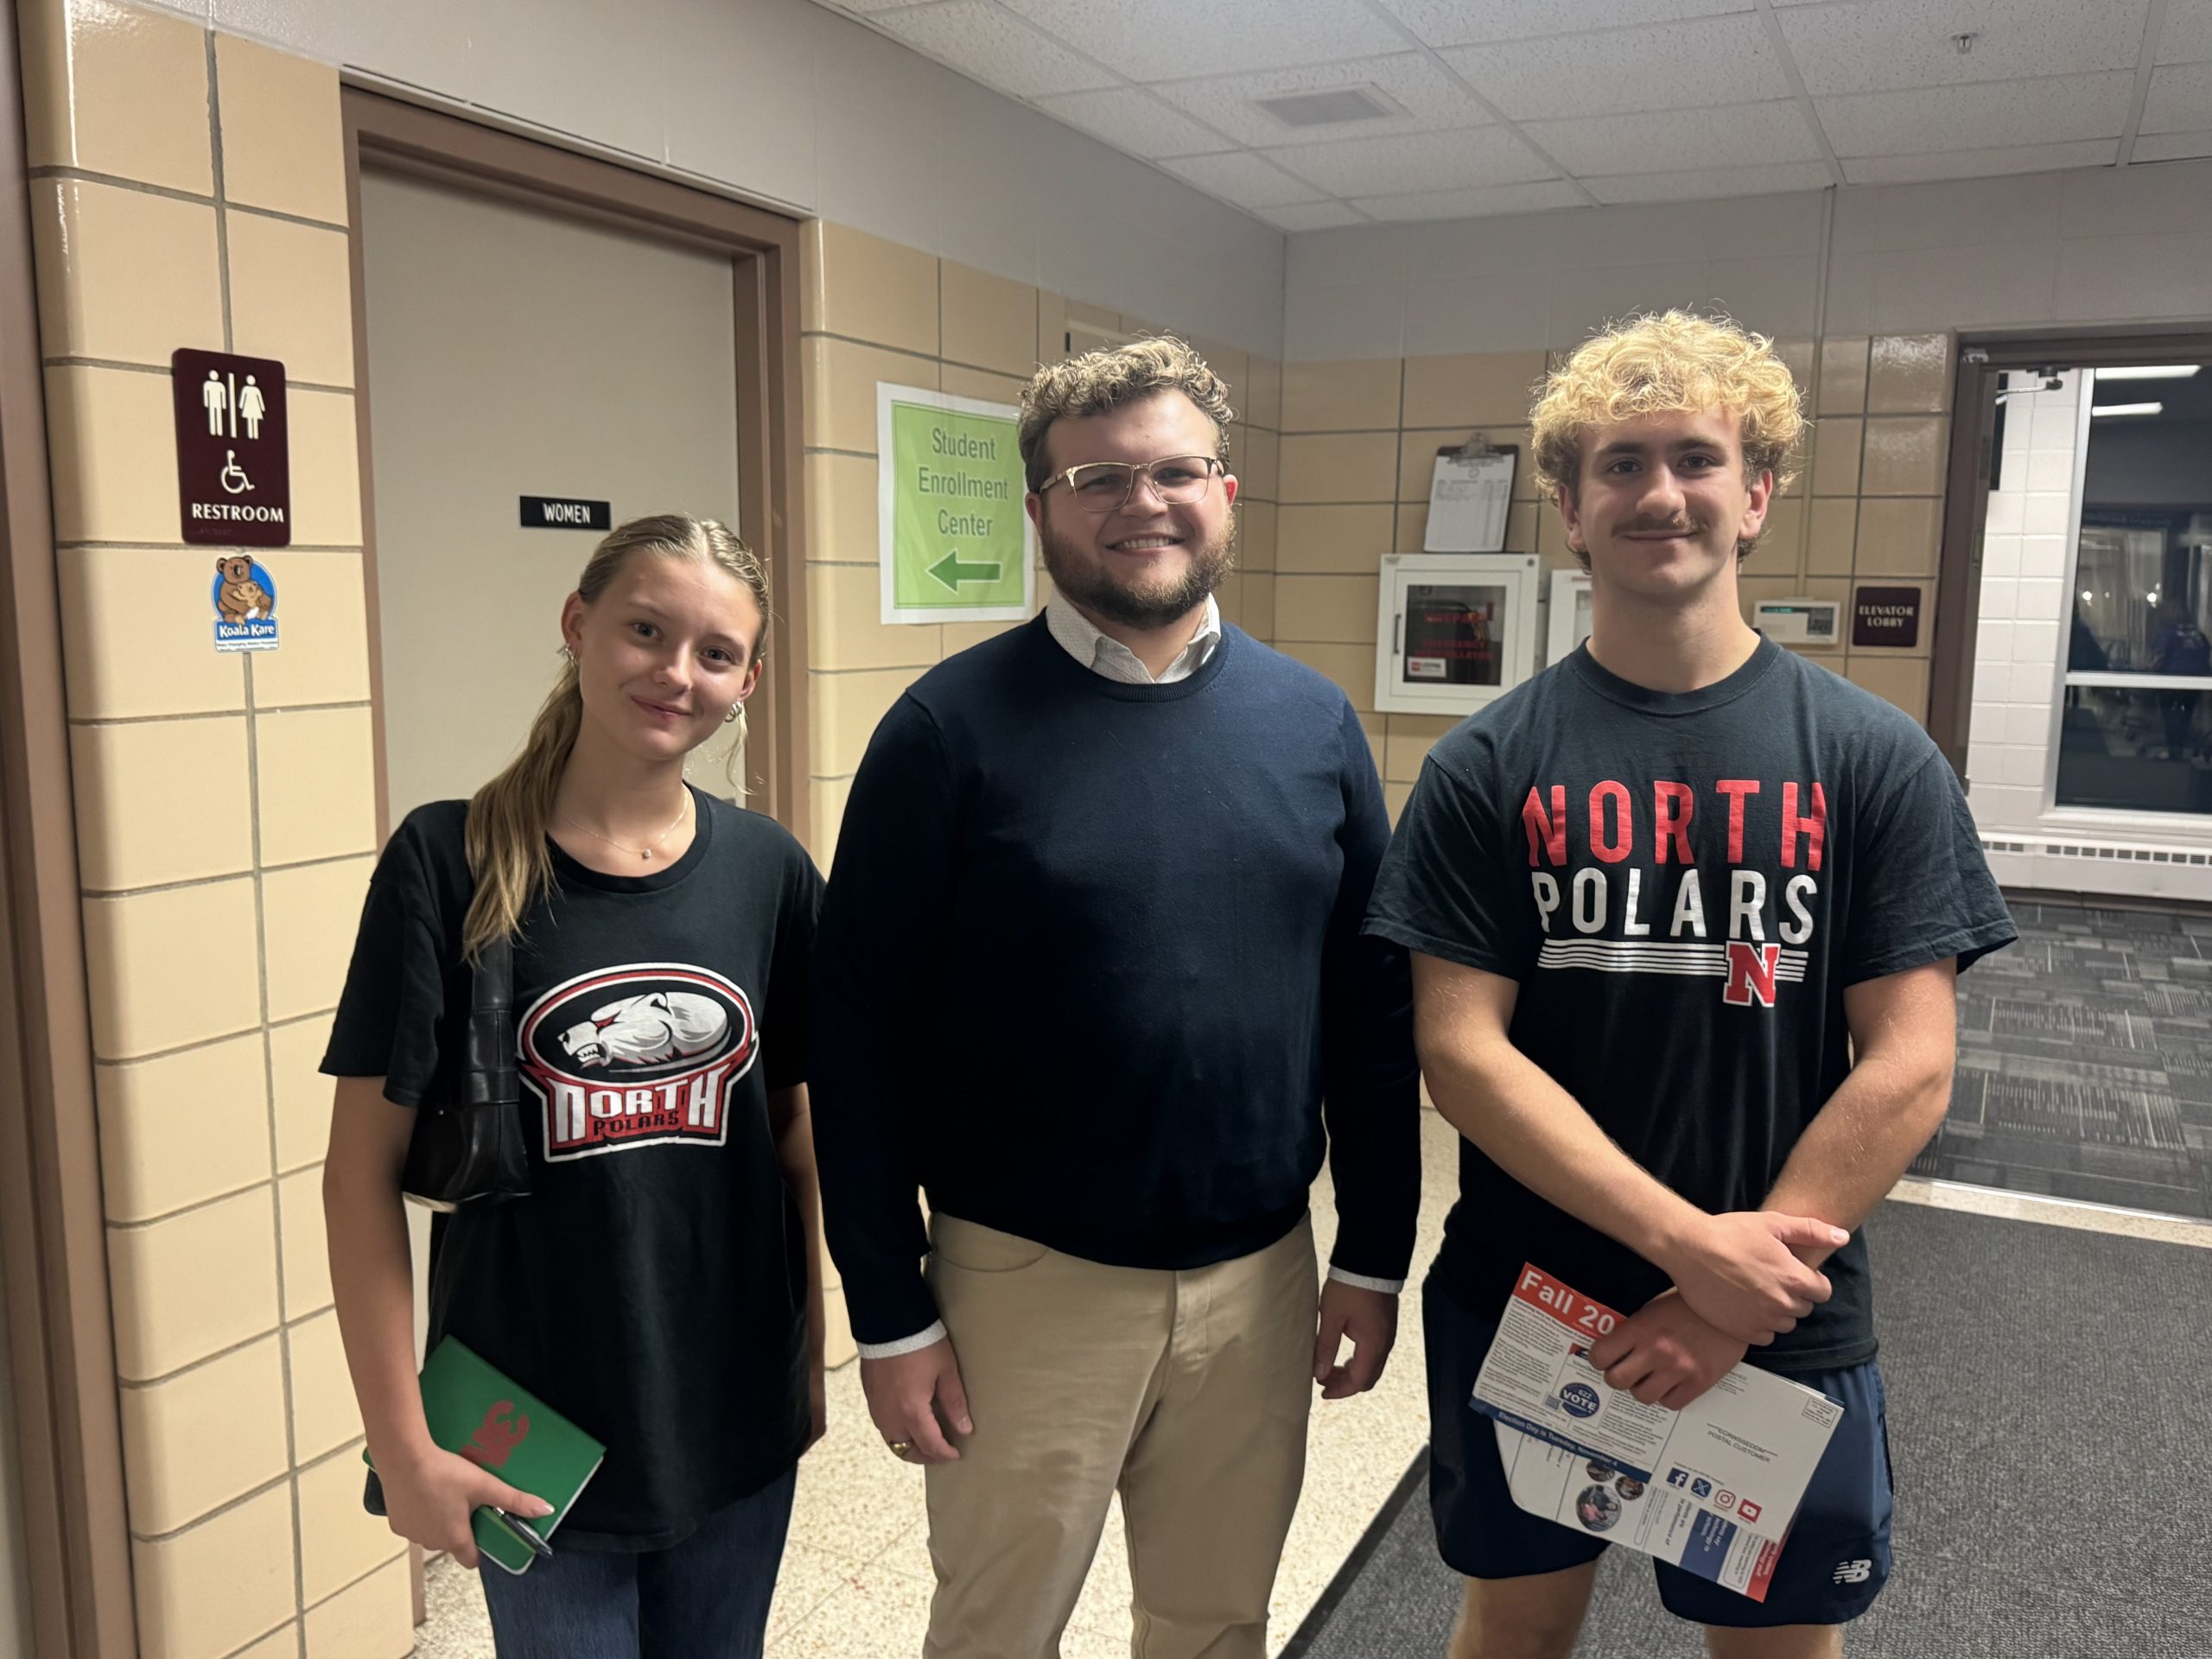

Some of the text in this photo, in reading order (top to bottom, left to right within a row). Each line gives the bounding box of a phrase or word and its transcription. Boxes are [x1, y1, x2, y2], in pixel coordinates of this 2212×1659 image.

[932, 428, 996, 461] Student
[918, 467, 1008, 499] Enrollment
[192, 503, 284, 523] RESTROOM
[543, 502, 591, 524] WOMEN
[938, 510, 994, 537] Center
[1859, 605, 1914, 617] ELEVATOR
[1867, 617, 1904, 628] LOBBY
[219, 624, 275, 638] Koala Kare
[1522, 779, 1827, 871] NORTH
[1532, 867, 1817, 944] POLARS
[1723, 940, 1781, 1007] N
[544, 1064, 732, 1142] NORTH
[594, 1110, 679, 1136] POLARS
[1521, 1270, 1573, 1314] Fall
[1564, 1389, 1598, 1411] VOTE
[1707, 1430, 1770, 1463] POSTAL CUSTOMER
